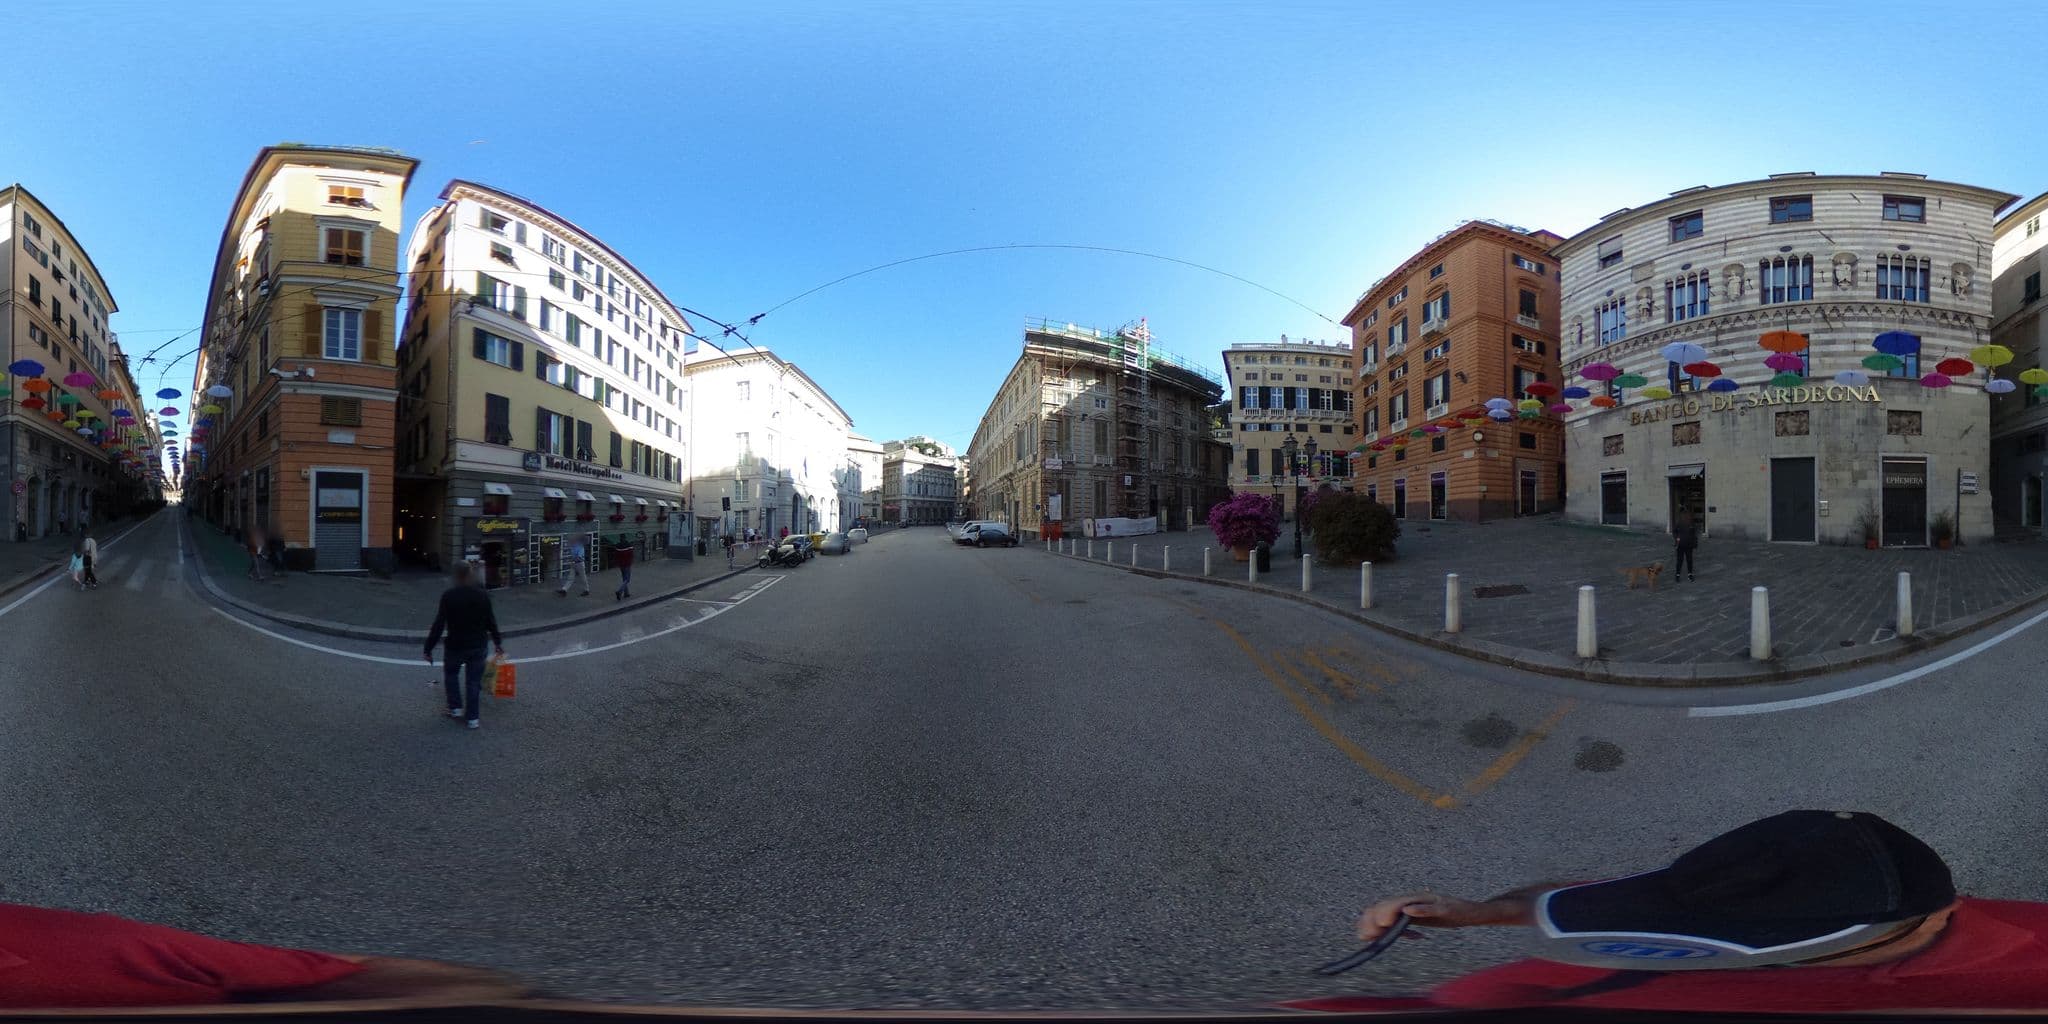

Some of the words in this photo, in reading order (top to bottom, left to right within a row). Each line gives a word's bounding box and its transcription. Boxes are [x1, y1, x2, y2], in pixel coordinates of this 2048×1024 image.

[1630, 399, 1700, 425] BANCO
[1711, 395, 1734, 412] DI
[1746, 384, 1881, 408] SARDEGNA
[546, 456, 572, 471] Hotel
